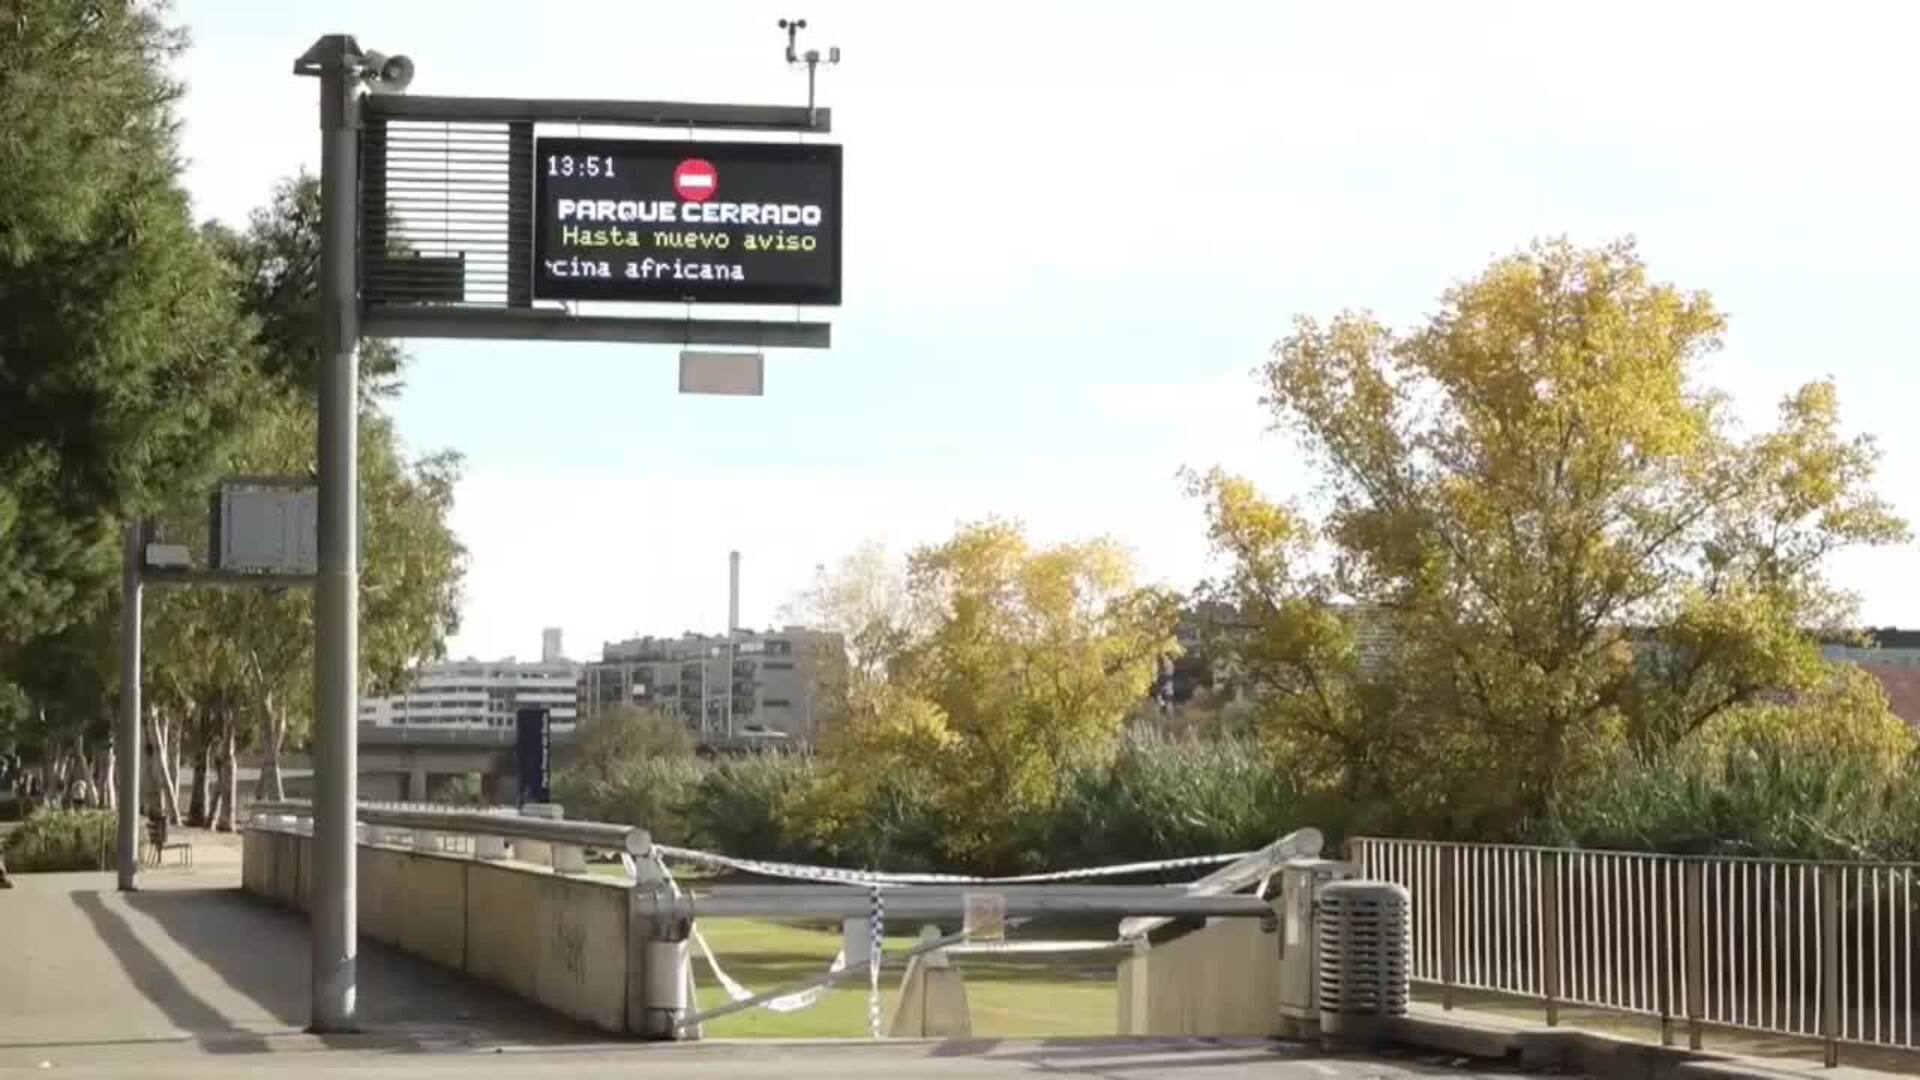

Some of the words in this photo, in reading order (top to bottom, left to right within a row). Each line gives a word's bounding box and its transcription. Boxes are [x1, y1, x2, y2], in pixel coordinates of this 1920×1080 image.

[547, 155, 615, 177] 13:51
[558, 199, 677, 223] PARQUE
[681, 202, 821, 226] CERRADO
[561, 225, 640, 247] Hasta
[653, 232, 730, 250] nuevo
[742, 229, 817, 251] aviso
[624, 258, 744, 280] africana
